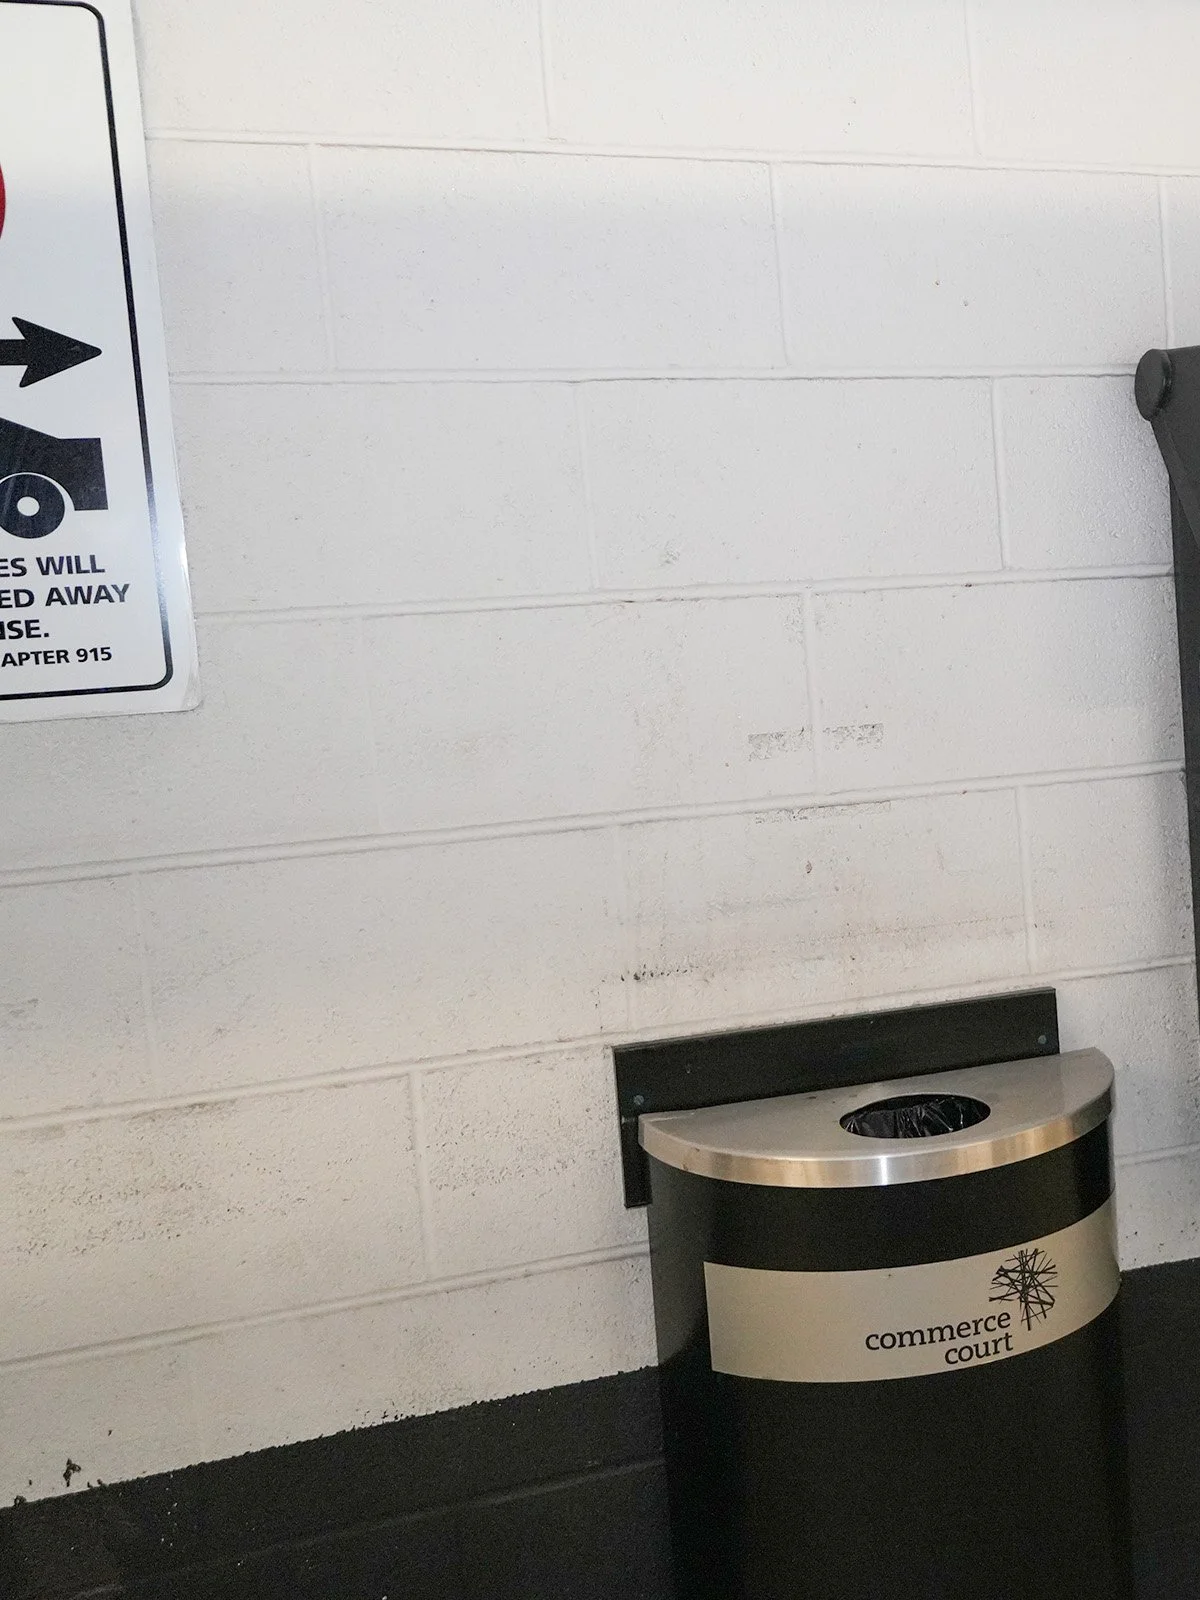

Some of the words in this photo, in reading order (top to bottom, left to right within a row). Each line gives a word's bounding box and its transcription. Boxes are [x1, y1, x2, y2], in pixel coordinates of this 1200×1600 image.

[35, 554, 106, 576] WILL
[45, 583, 130, 607] AWAY
[76, 646, 113, 663] 915
[865, 1311, 1011, 1350] commerce
[944, 1332, 1014, 1365] court
